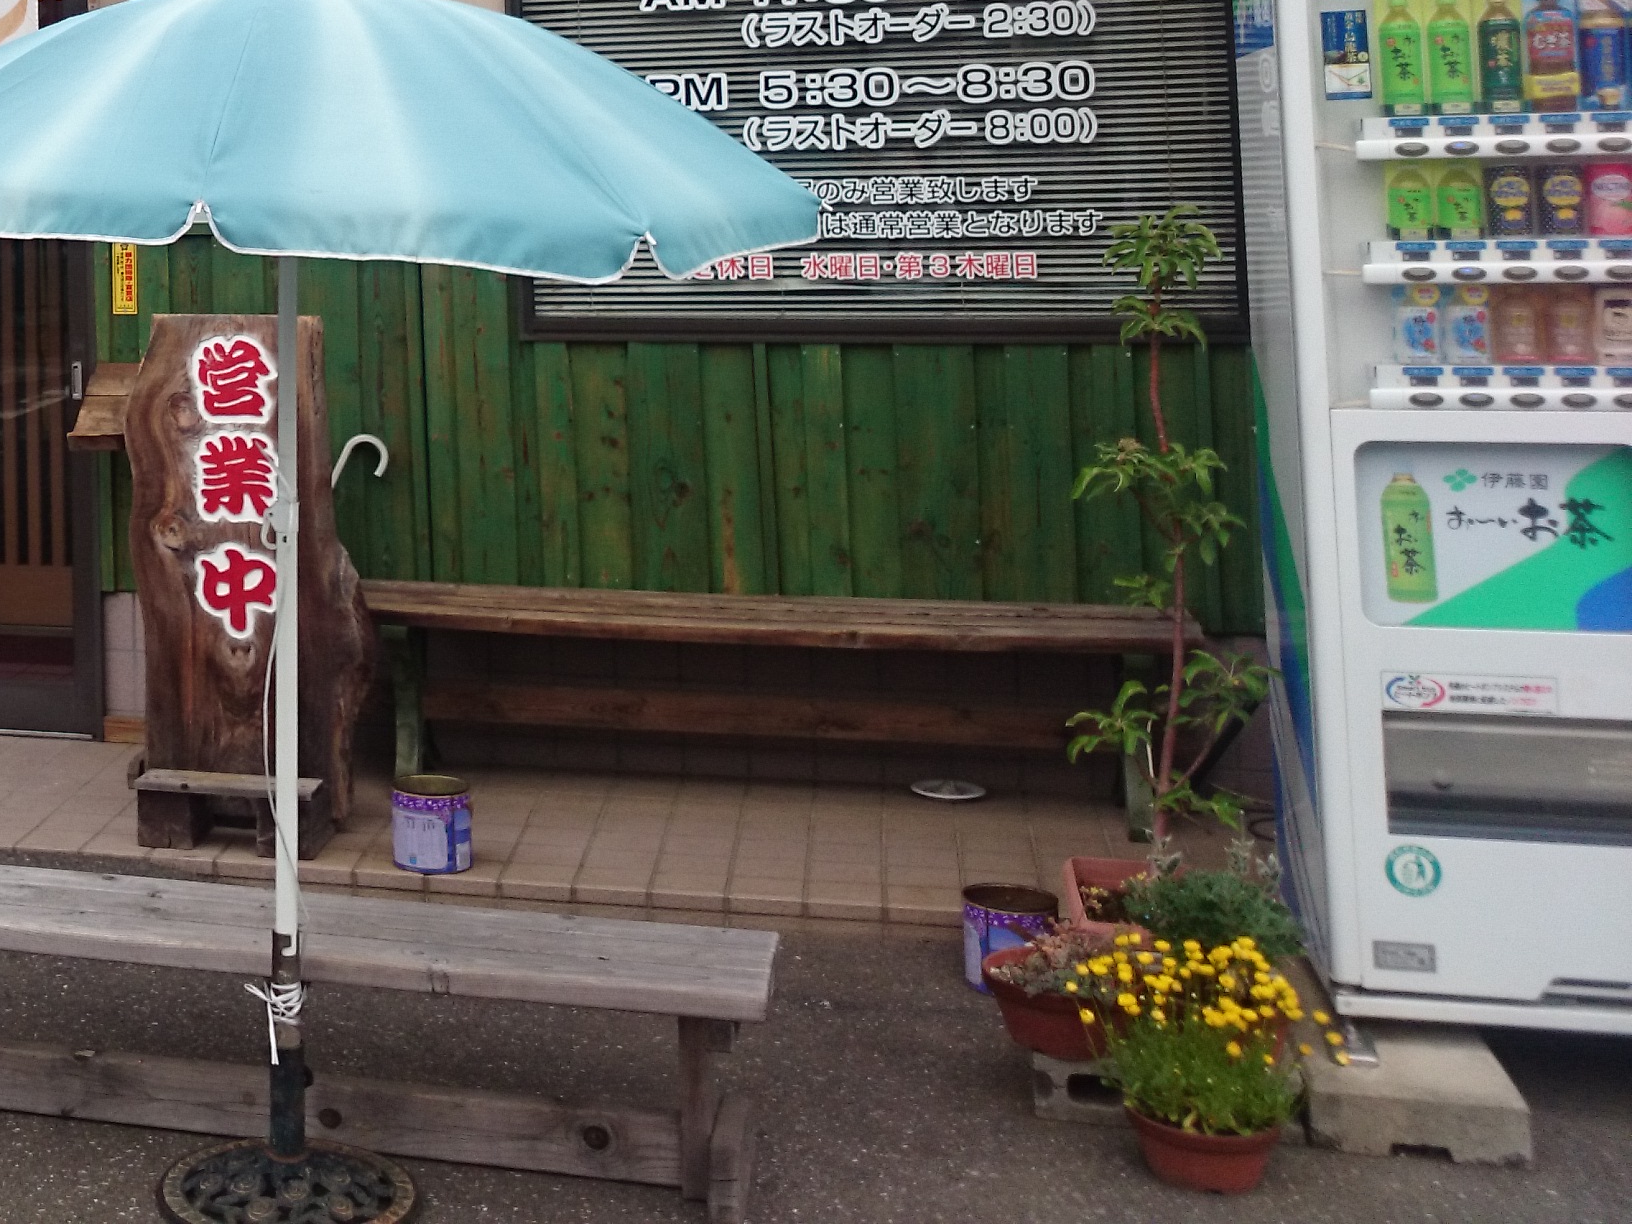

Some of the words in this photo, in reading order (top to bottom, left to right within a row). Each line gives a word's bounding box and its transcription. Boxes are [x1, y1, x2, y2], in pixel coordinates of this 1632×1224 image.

[817, 210, 1103, 240] は通常営業となります
[193, 333, 276, 637] 営業中
[1481, 473, 1548, 490] 伊藤園
